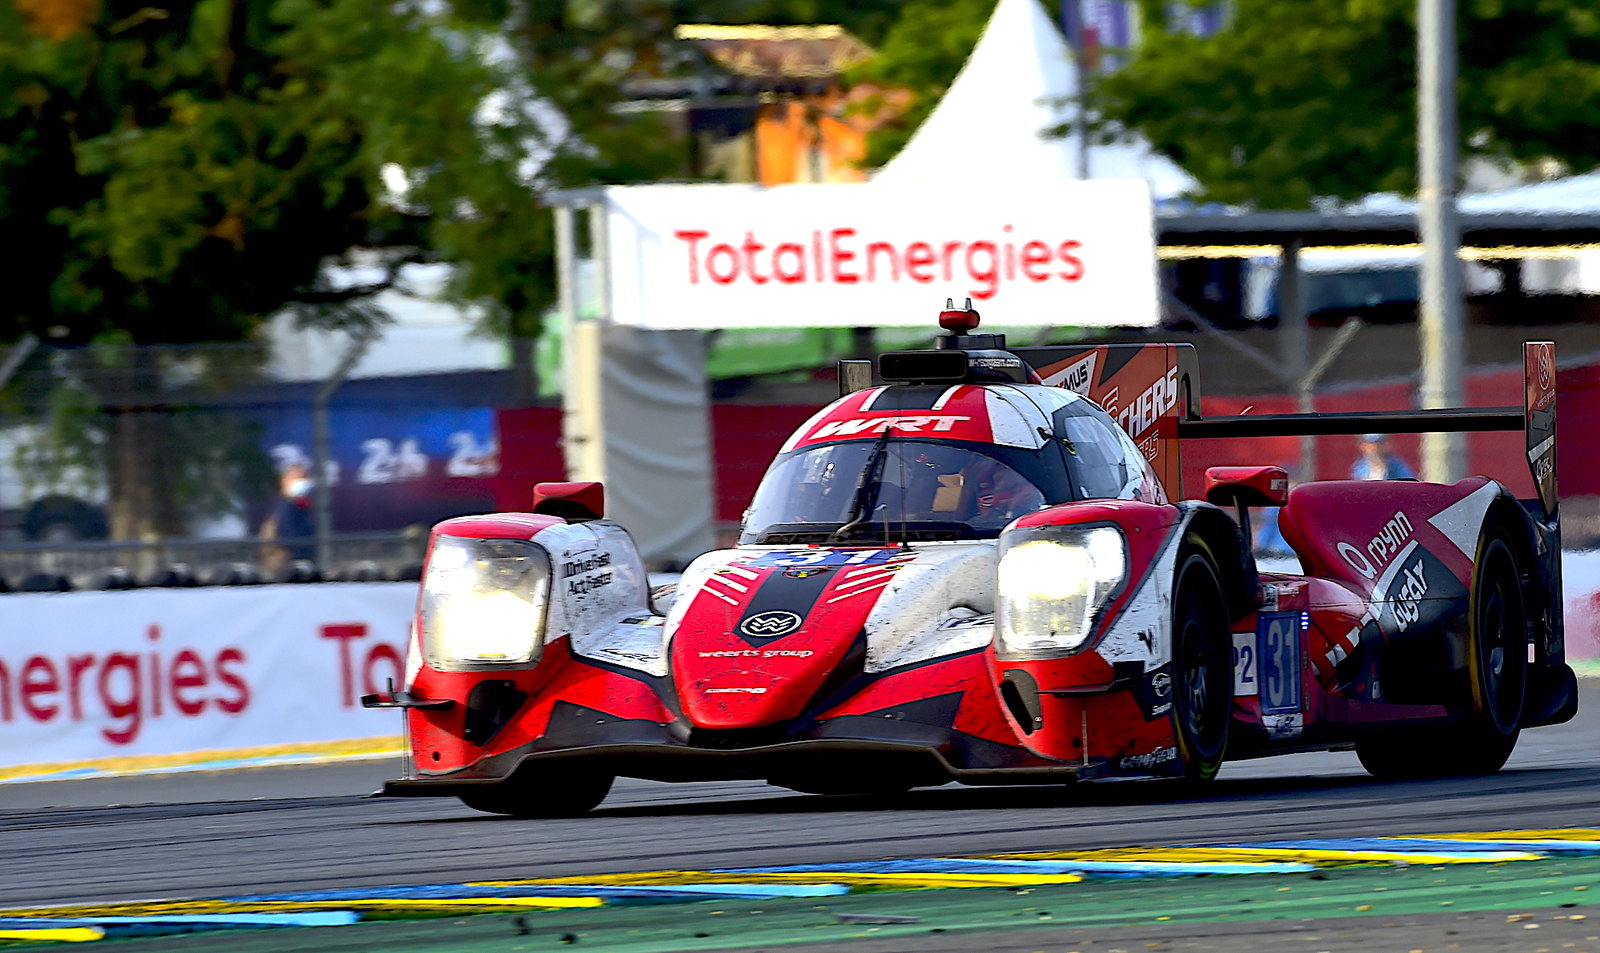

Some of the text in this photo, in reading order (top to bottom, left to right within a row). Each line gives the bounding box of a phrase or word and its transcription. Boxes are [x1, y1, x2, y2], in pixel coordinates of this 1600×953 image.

[674, 224, 1086, 300] TotalEnergies
[1056, 363, 1088, 391] MUS
[1115, 365, 1178, 440] CHERS
[808, 415, 972, 440] WRT
[773, 548, 882, 566] 31
[318, 619, 412, 708] To
[698, 649, 814, 659] weerts group
[1268, 619, 1296, 707] 31
